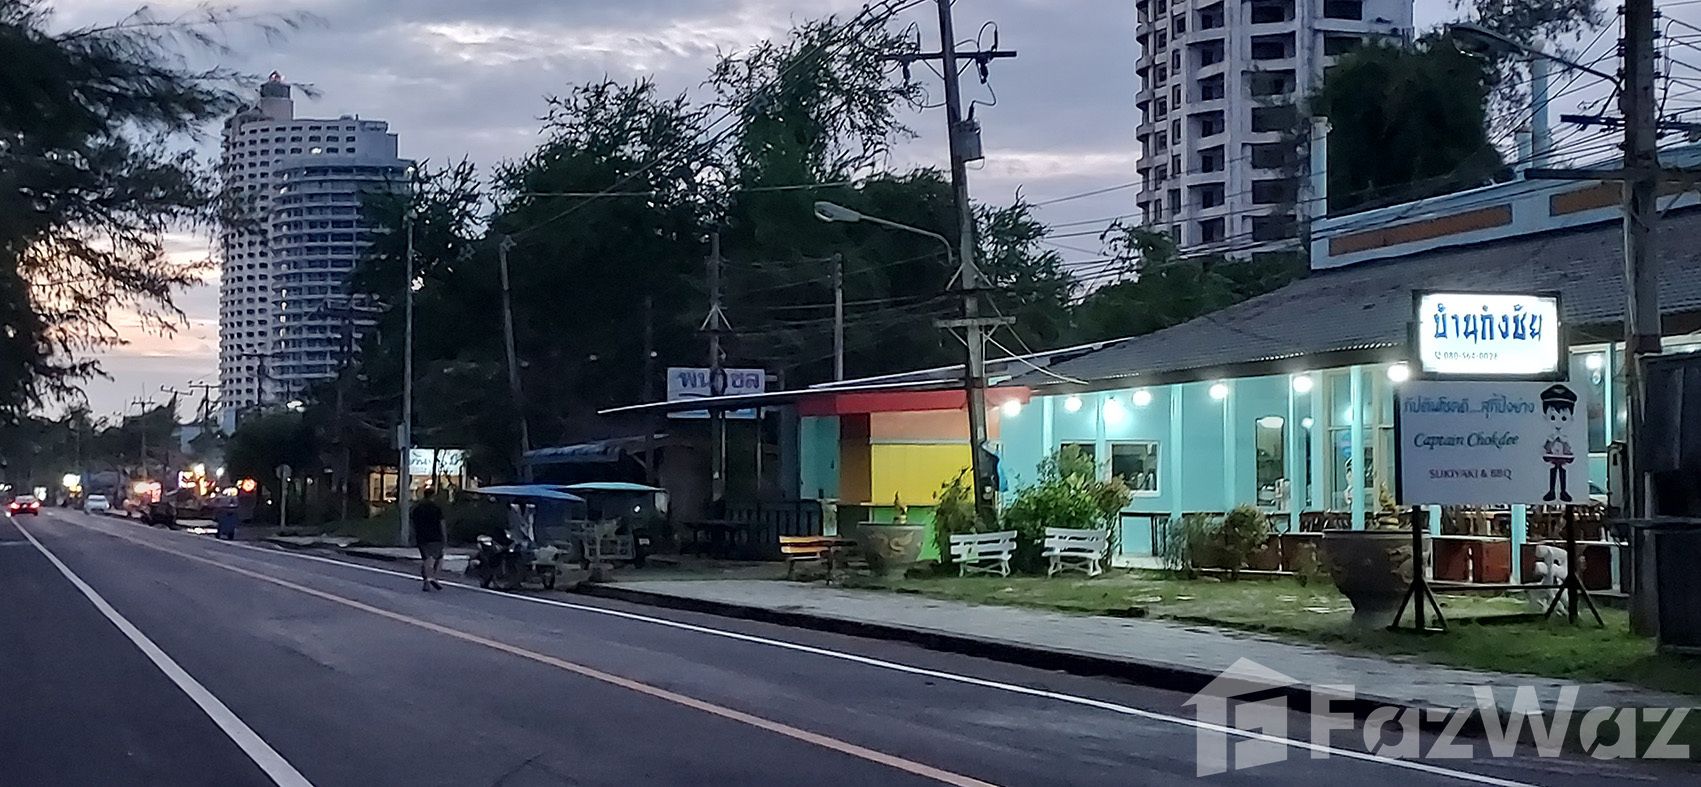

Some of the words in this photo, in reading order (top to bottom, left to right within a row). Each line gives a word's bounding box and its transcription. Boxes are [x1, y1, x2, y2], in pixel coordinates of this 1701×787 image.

[1413, 432, 1464, 450] Captain
[1467, 431, 1519, 449] Chokdee
[1428, 468, 1478, 479] SUKIYAKI
[1490, 468, 1512, 480] BBQ
